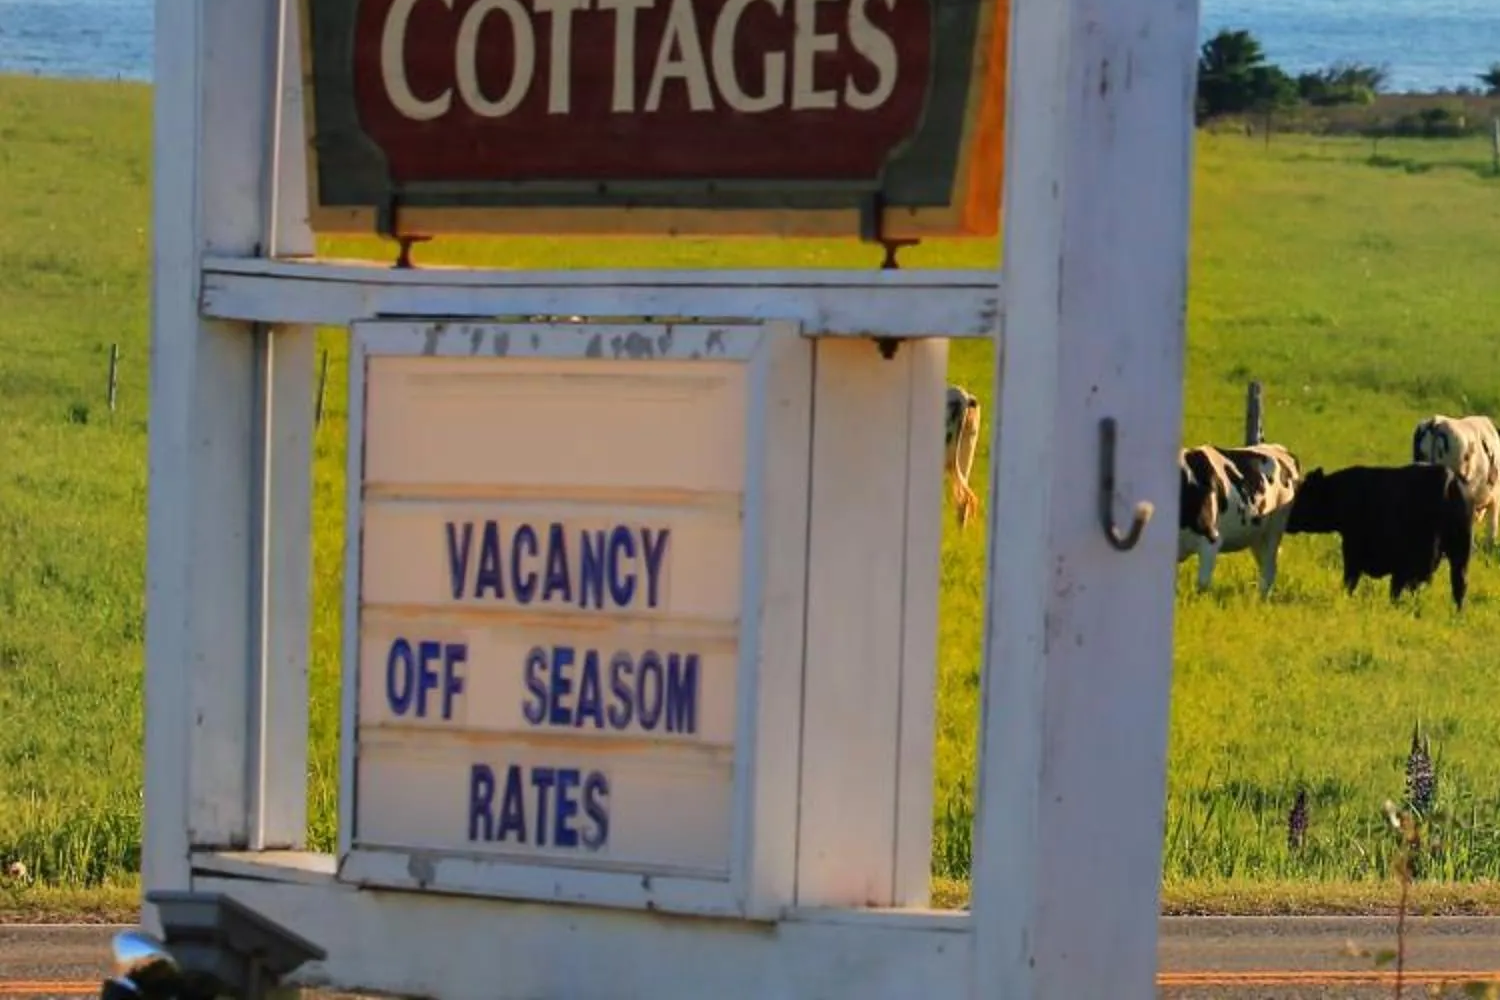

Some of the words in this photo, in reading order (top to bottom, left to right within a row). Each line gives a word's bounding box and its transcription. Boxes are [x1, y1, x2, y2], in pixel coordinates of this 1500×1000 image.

[446, 520, 669, 609] VACANCY
[387, 637, 466, 719] OFF
[469, 763, 609, 849] RATES
